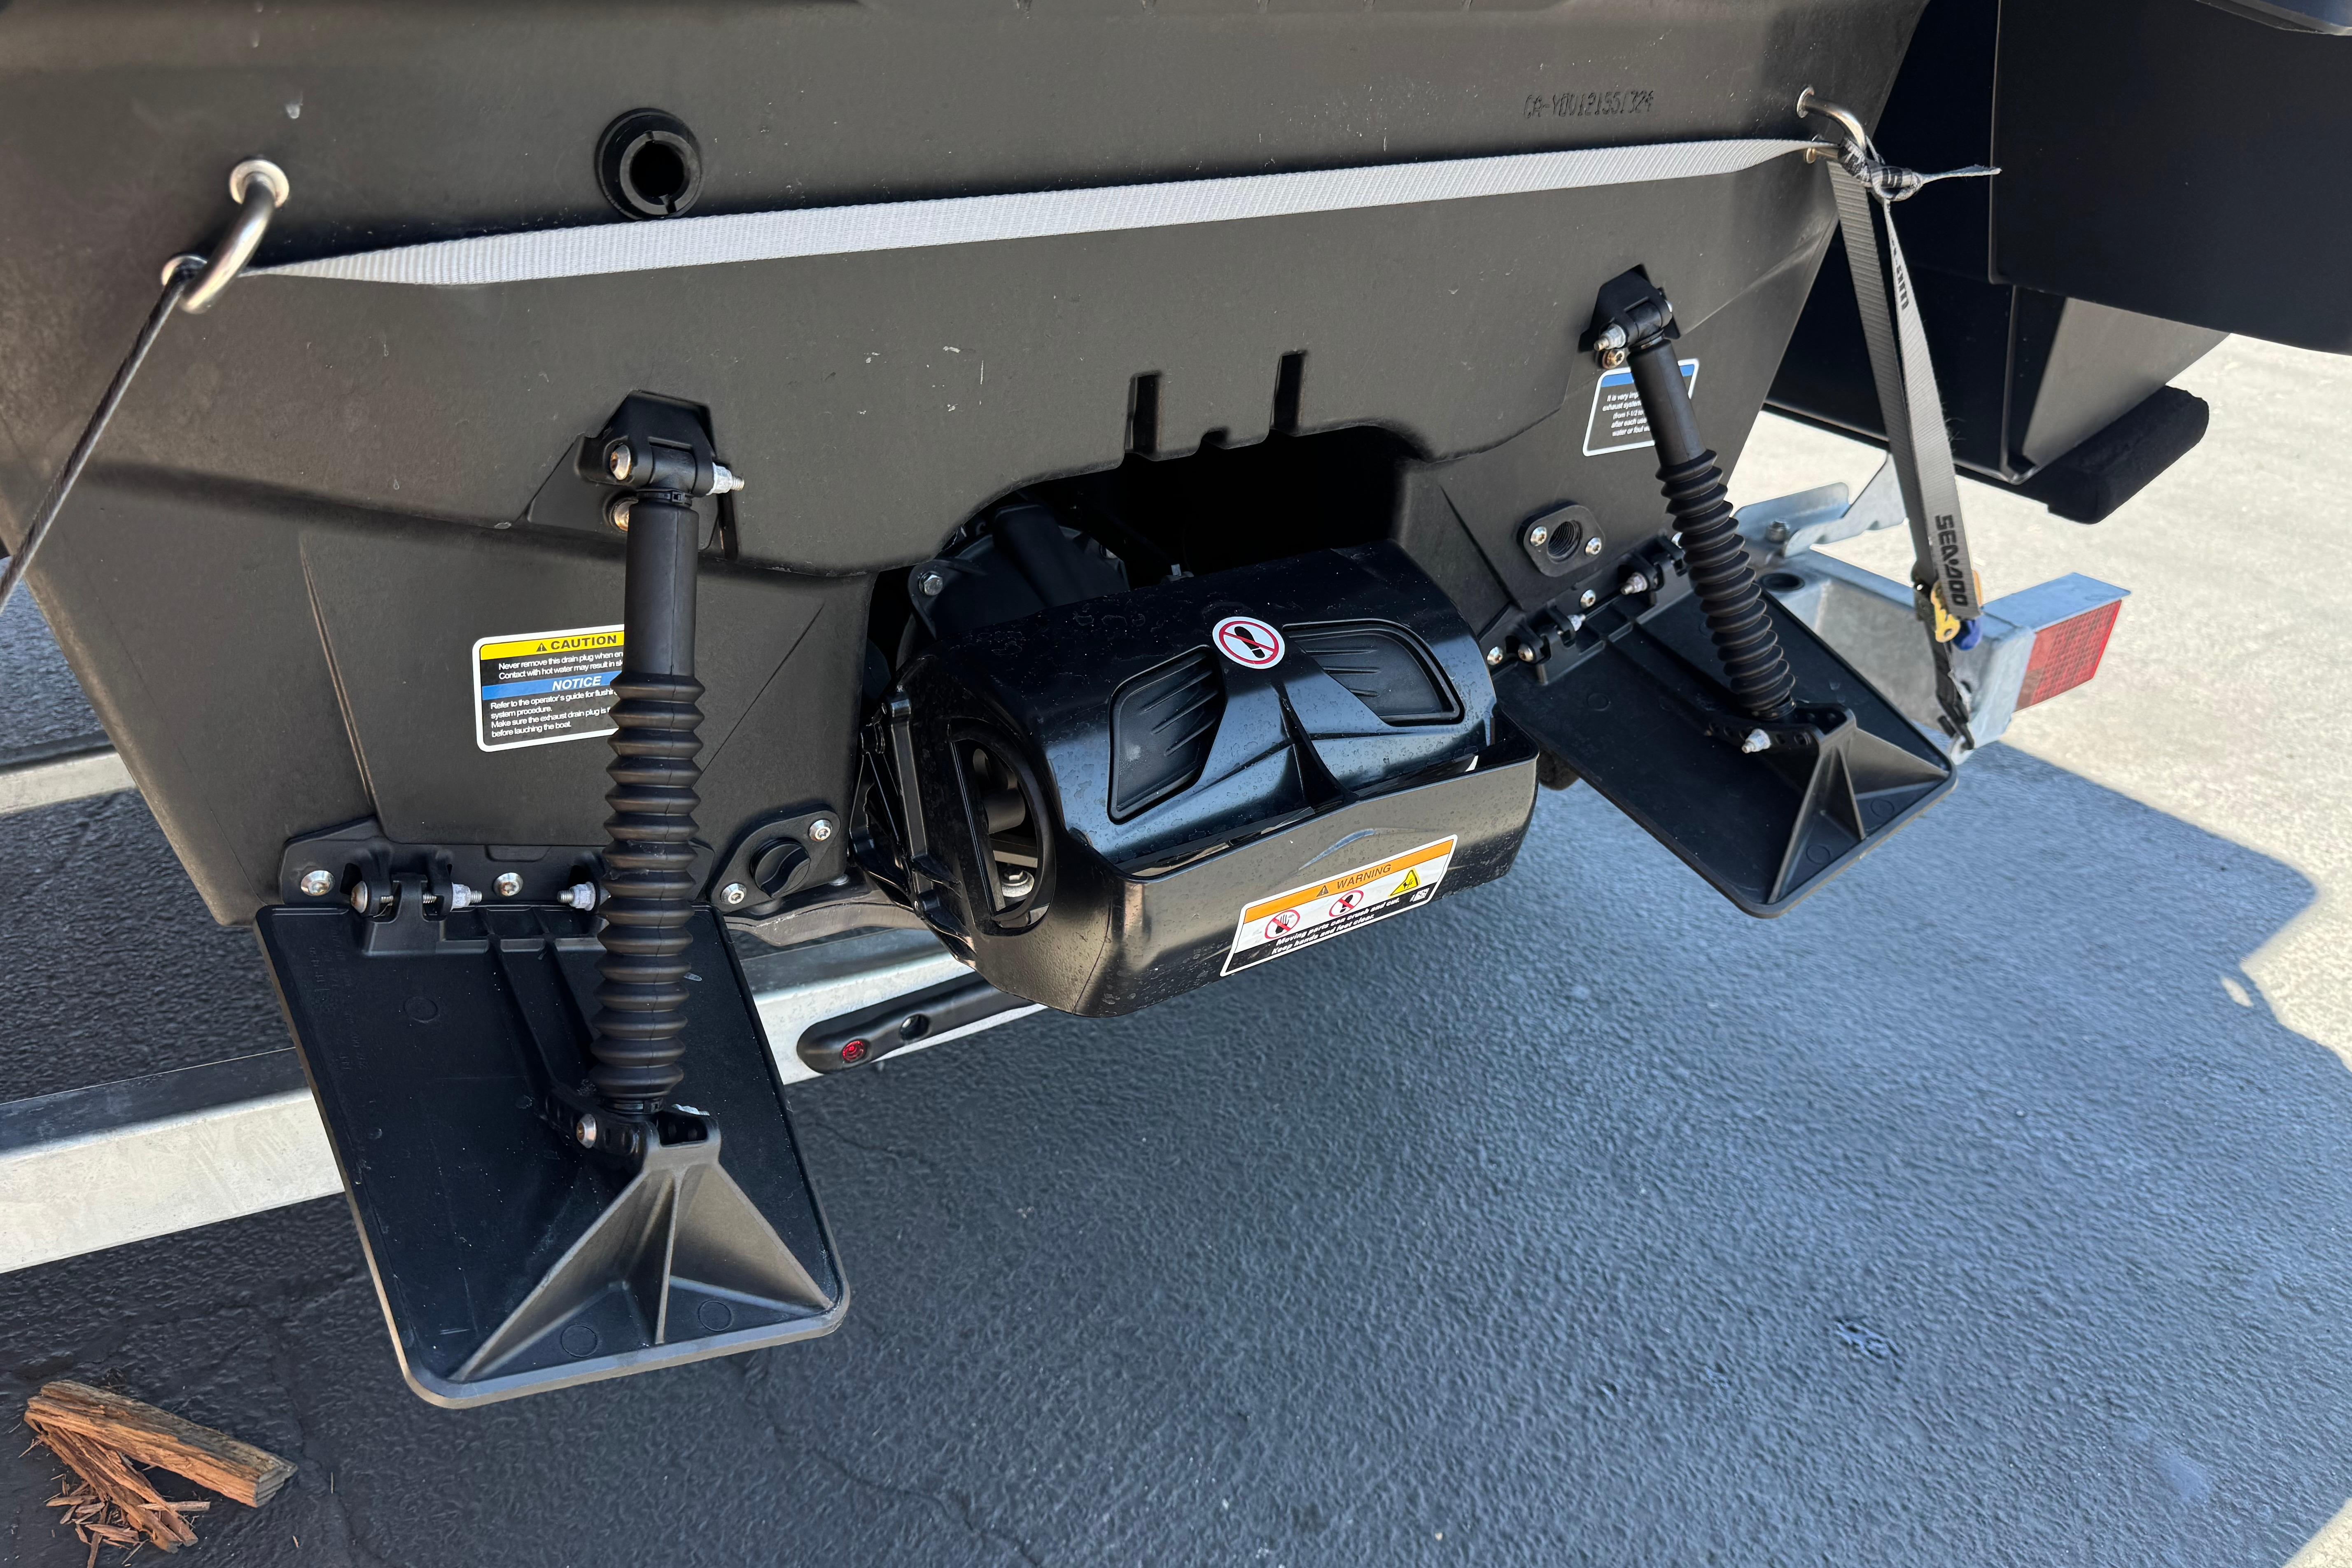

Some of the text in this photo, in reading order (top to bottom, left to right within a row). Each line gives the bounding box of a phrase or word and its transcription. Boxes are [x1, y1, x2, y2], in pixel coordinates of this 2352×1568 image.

[1602, 400, 1642, 411] exhaust system
[1624, 418, 1637, 427] each
[551, 635, 616, 650] CAUTION
[579, 654, 594, 663] plug
[499, 670, 526, 680] Contact
[590, 661, 608, 670] result
[552, 675, 602, 691] NOTICE
[490, 701, 510, 709] Refer
[530, 694, 565, 705] operator's
[565, 692, 585, 702] guide
[490, 706, 553, 720] system procedure.
[491, 720, 511, 729] Make
[540, 712, 567, 721] exhaust
[567, 710, 584, 718] drain
[585, 708, 600, 717] plug
[492, 729, 513, 737] before
[1337, 864, 1391, 889] WARNING
[1276, 931, 1307, 946] Moving
[1307, 923, 1330, 936] parts
[1330, 917, 1346, 926] can
[1347, 908, 1370, 921] crush
[1370, 902, 1387, 913] and
[1271, 914, 1375, 955] Keep hands and feet clear.
